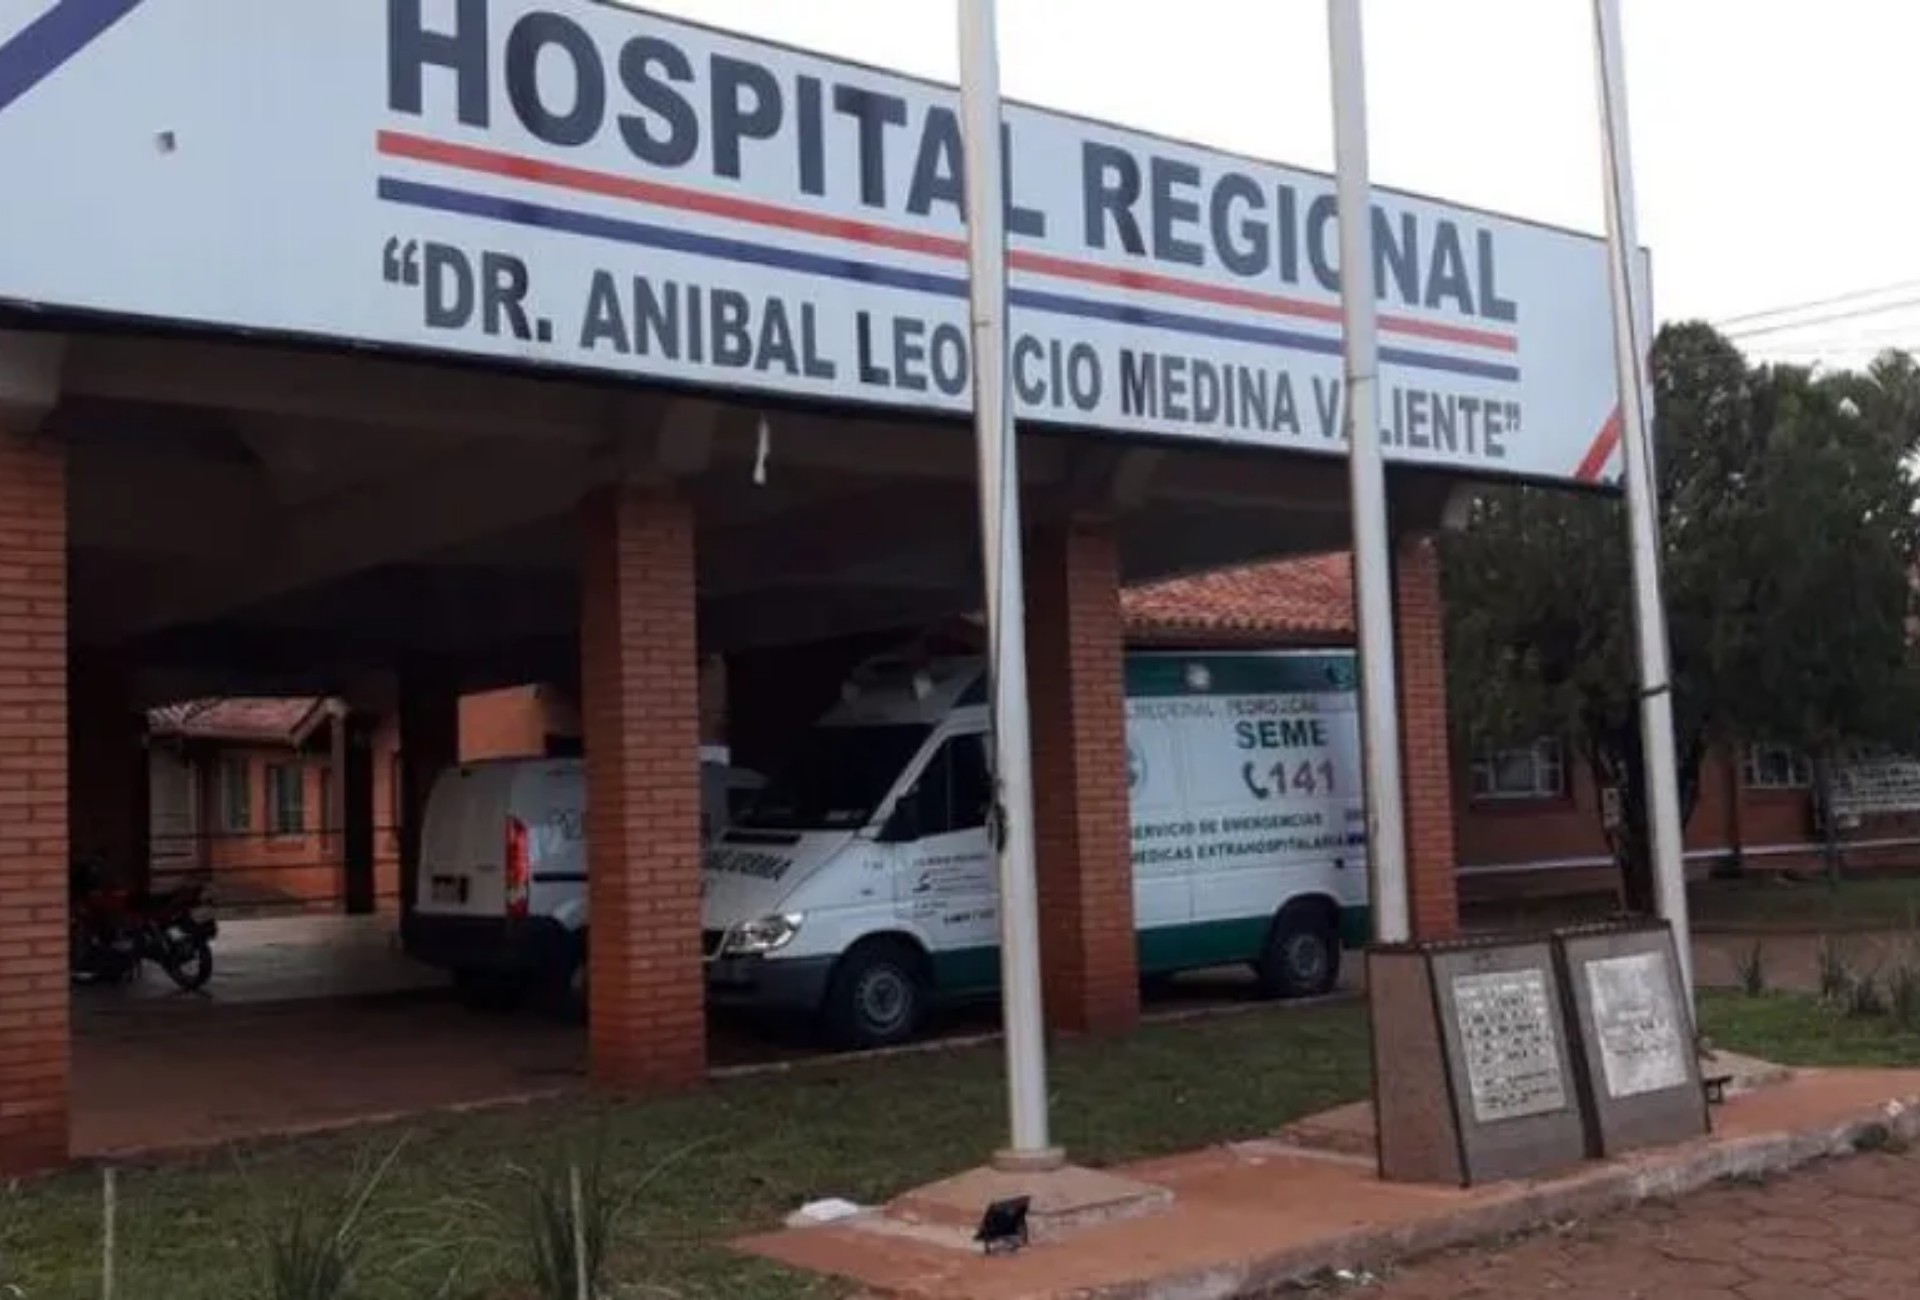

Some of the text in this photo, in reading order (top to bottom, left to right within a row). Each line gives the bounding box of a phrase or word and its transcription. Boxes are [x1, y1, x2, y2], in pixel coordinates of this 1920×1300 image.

[387, 0, 1518, 323] HOSPITAL REGIONAL
[580, 269, 836, 381] ANIBAL
[856, 310, 1101, 411] LEOCIO
[1119, 348, 1300, 434] MEDINA
[1312, 374, 1521, 457] VIENTE”
[1235, 719, 1328, 750] SEME
[1268, 758, 1335, 794] 141
[1199, 818, 1218, 834] DE
[1221, 812, 1322, 832] EMERGENCIAS
